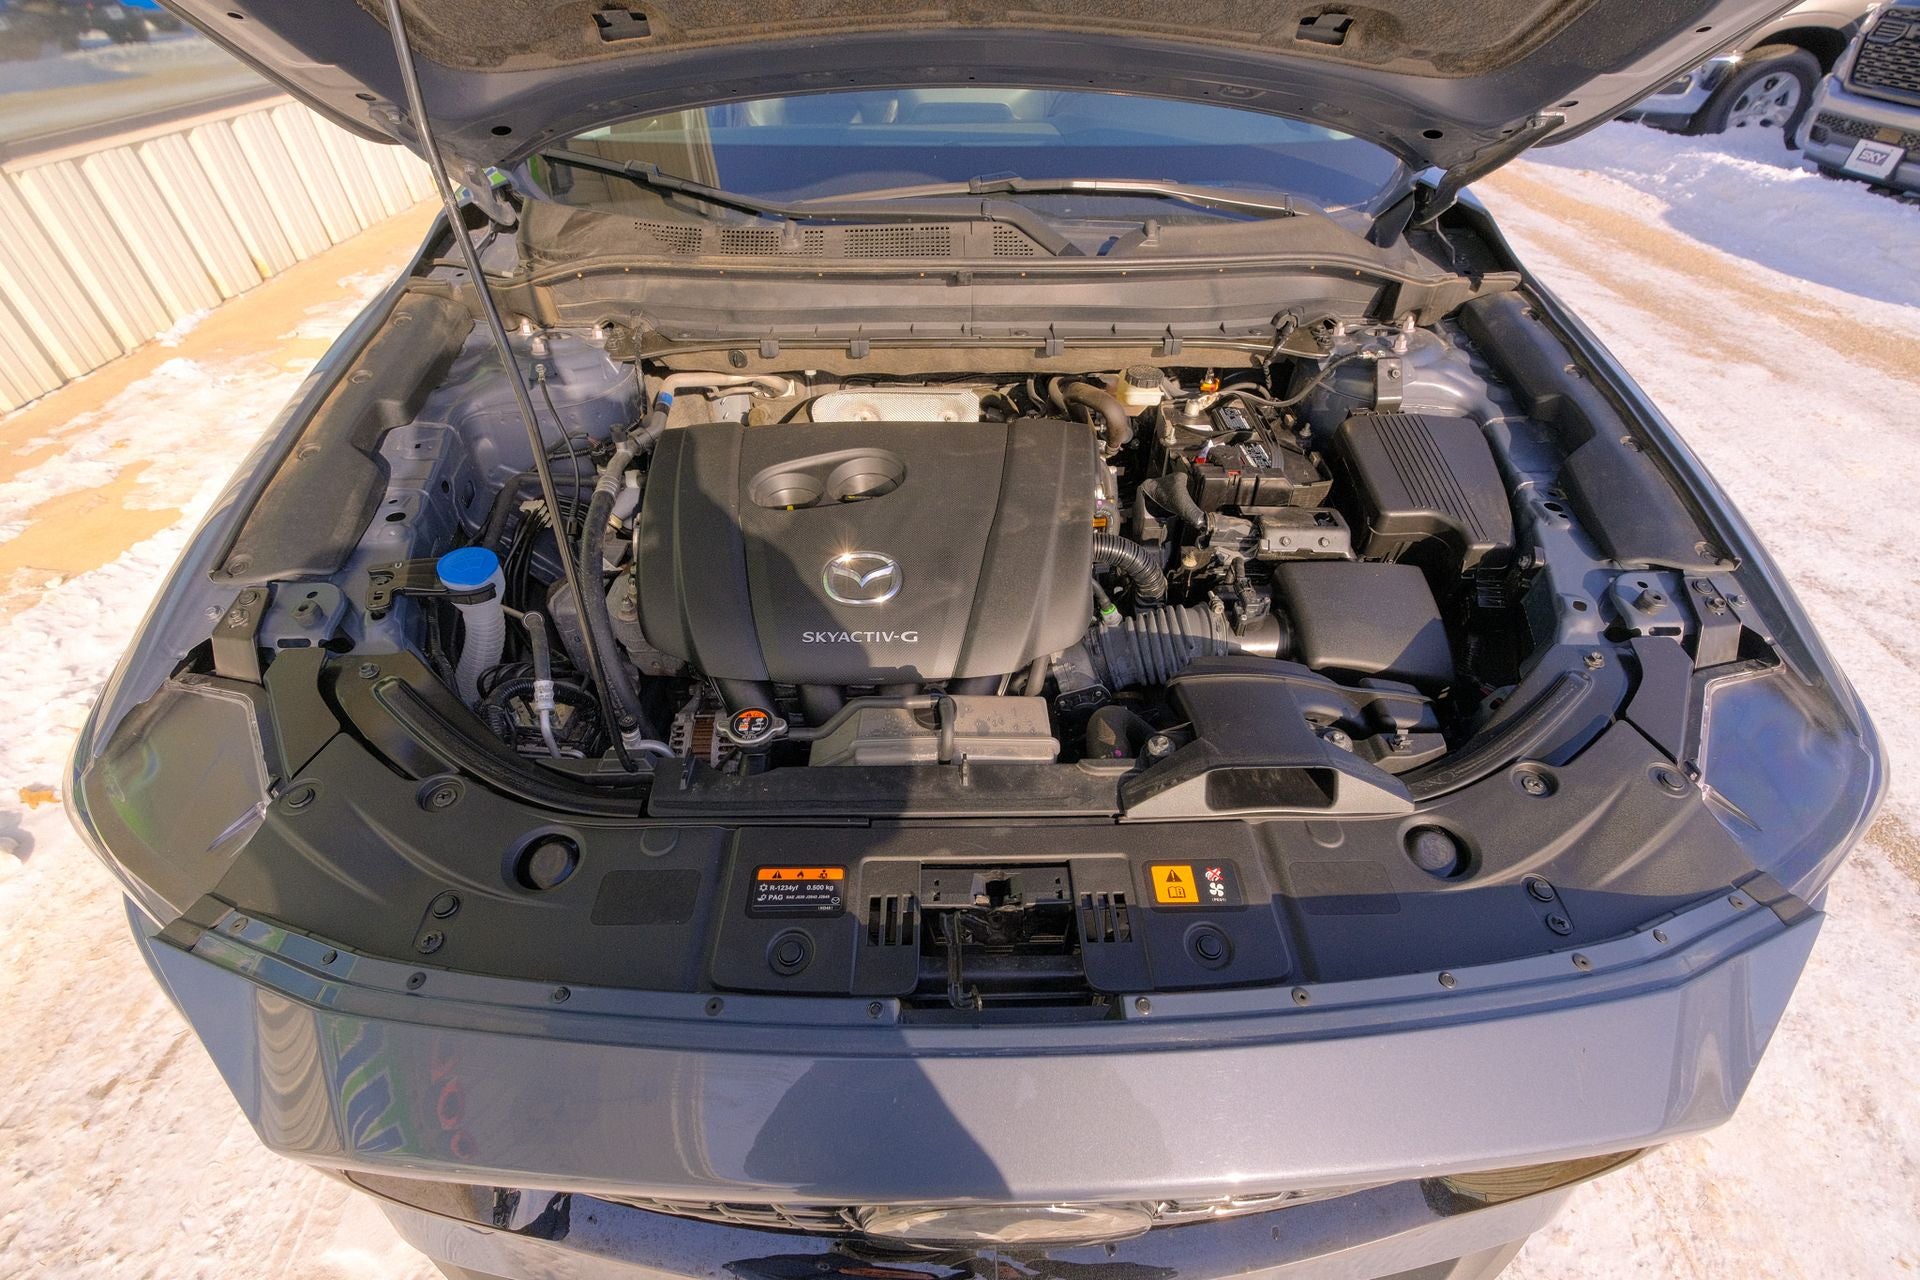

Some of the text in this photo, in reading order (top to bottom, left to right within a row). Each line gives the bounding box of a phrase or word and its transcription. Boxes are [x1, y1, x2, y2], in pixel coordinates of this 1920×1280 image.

[1858, 149, 1887, 164] SKY
[801, 631, 918, 643] SKYACTIV-G
[769, 884, 799, 892] R-1234yf
[825, 884, 834, 892] kg
